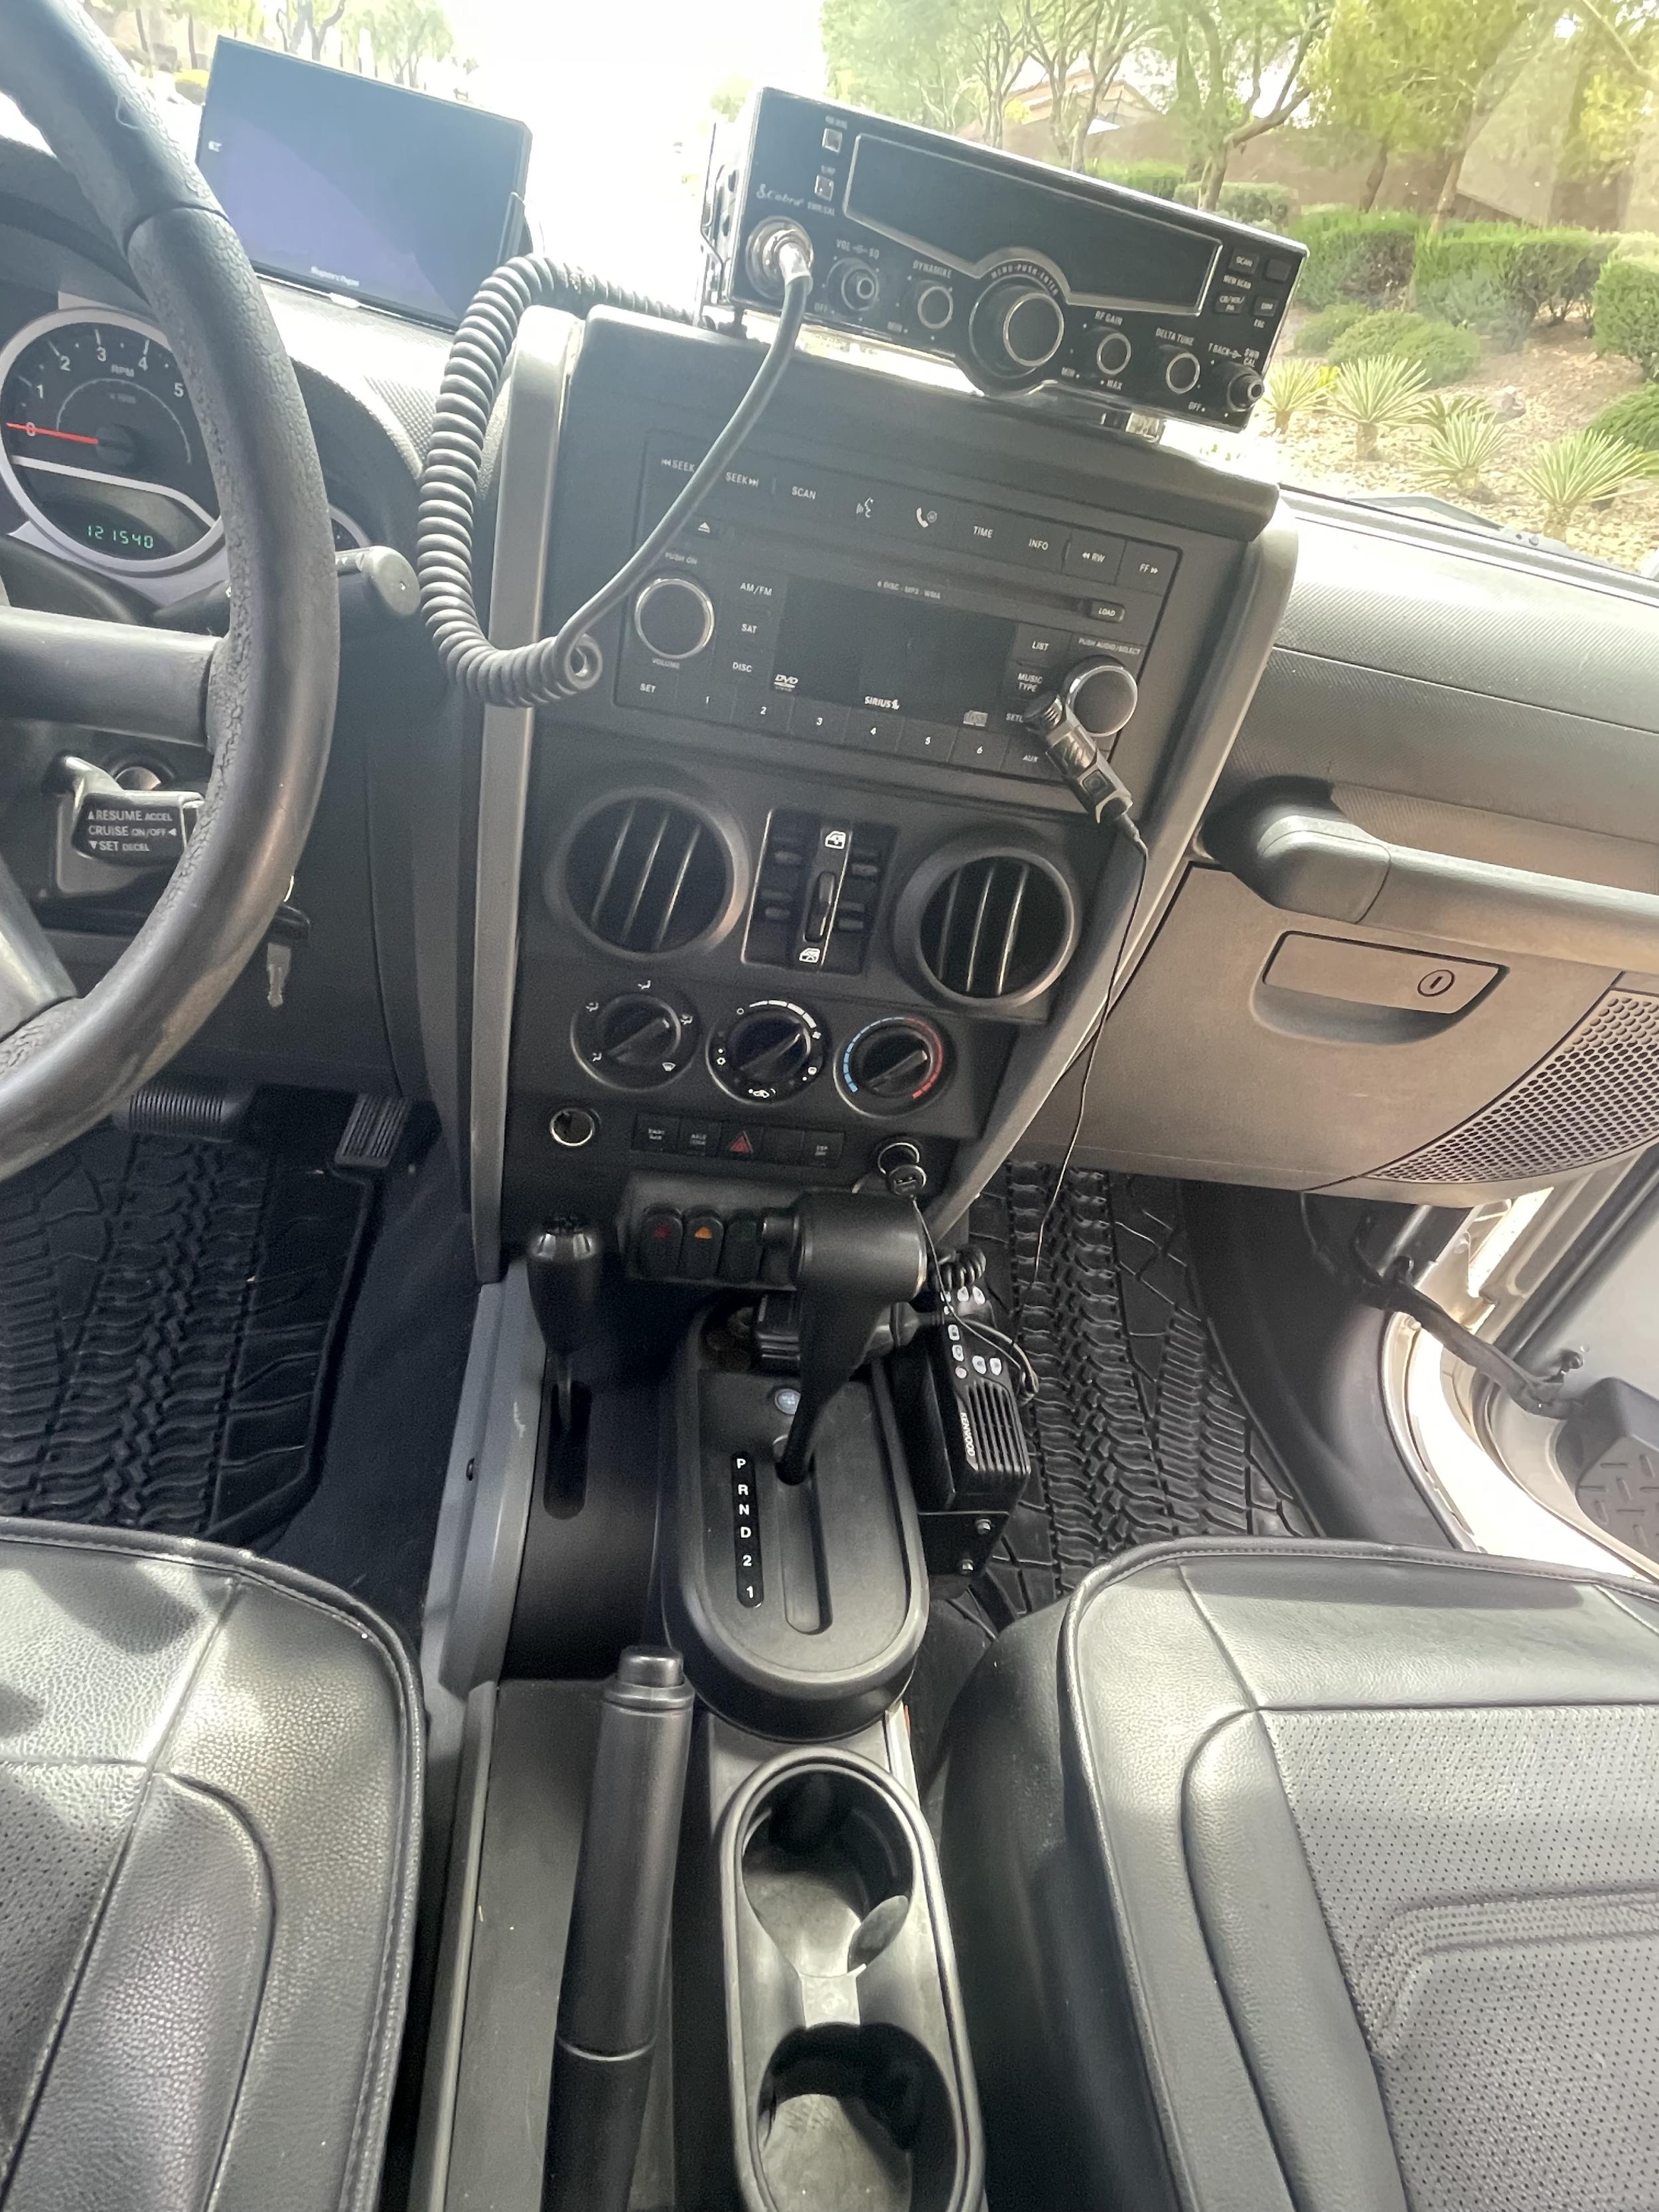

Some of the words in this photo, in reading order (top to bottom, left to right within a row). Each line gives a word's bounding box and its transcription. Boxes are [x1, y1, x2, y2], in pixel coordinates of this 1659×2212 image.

[836, 239, 849, 252] VOL
[1236, 256, 1253, 267] SCAN
[814, 303, 828, 313] OFF
[1105, 313, 1123, 325] GAIN
[1156, 328, 1176, 341] DELTA
[1177, 334, 1194, 346] TUNE
[97, 346, 106, 362] 3
[60, 355, 71, 372] 2
[138, 356, 148, 372] 4
[174, 382, 184, 397] 5
[1107, 380, 1123, 390] MAX
[36, 384, 43, 398] 1
[1188, 402, 1201, 411] OFF
[27, 421, 36, 437] 0
[672, 459, 695, 473] SEEK
[726, 472, 748, 484] SEEK
[792, 486, 816, 499] SCAN
[88, 525, 154, 549] 121540
[974, 526, 993, 538] TIME
[1029, 539, 1048, 551] INFO
[665, 552, 684, 562] PUSH
[1092, 553, 1106, 563] RW
[1139, 563, 1150, 573] FF
[740, 583, 772, 596] AM/FM
[1099, 608, 1116, 617] LOAD
[741, 624, 757, 633] SAT
[1032, 640, 1048, 650] LIST
[1078, 637, 1096, 646] PUSH
[652, 658, 680, 669] VOLUME
[733, 662, 753, 673] DISC
[775, 674, 798, 685] DVD
[1018, 673, 1043, 684] MUSIC
[640, 683, 656, 693] SET
[1019, 682, 1038, 692] TYPE
[864, 696, 892, 709] SIRIUS
[760, 706, 766, 715] 2
[816, 717, 823, 725] 3
[96, 810, 143, 821] RESUME
[145, 812, 173, 822] ACCEL
[88, 826, 129, 836] CRUISE
[132, 828, 167, 838] ON/OFF
[100, 840, 118, 851] SET
[122, 843, 150, 851] DECEL
[960, 1412, 975, 1456] KENWOOD
[737, 1459, 746, 1469] P
[738, 1484, 749, 1495] R
[739, 1504, 750, 1515] N
[741, 1526, 751, 1538] D
[743, 1554, 752, 1566] 2
[746, 1585, 754, 1598] 1
